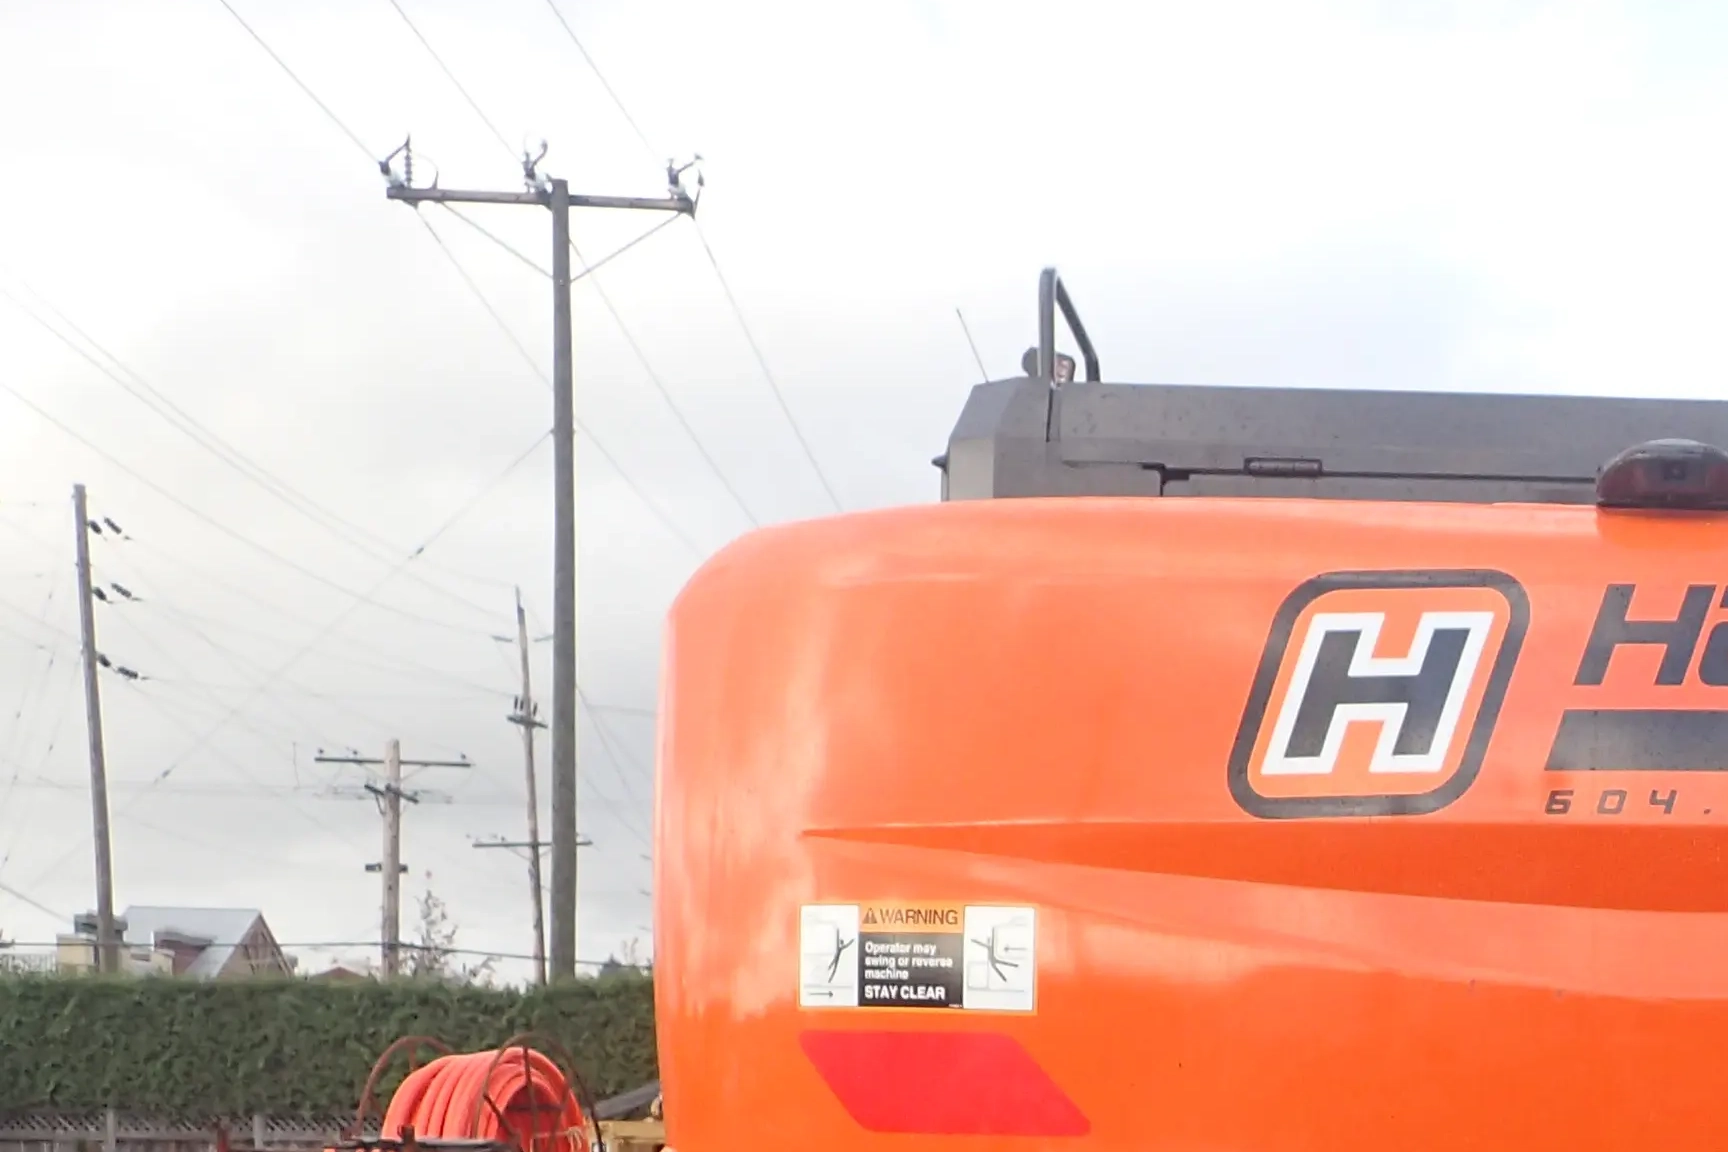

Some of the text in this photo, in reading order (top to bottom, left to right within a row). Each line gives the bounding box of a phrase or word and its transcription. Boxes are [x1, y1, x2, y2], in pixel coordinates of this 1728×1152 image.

[880, 909, 958, 926] WARNING
[865, 985, 945, 1000] STAY CLEAR
